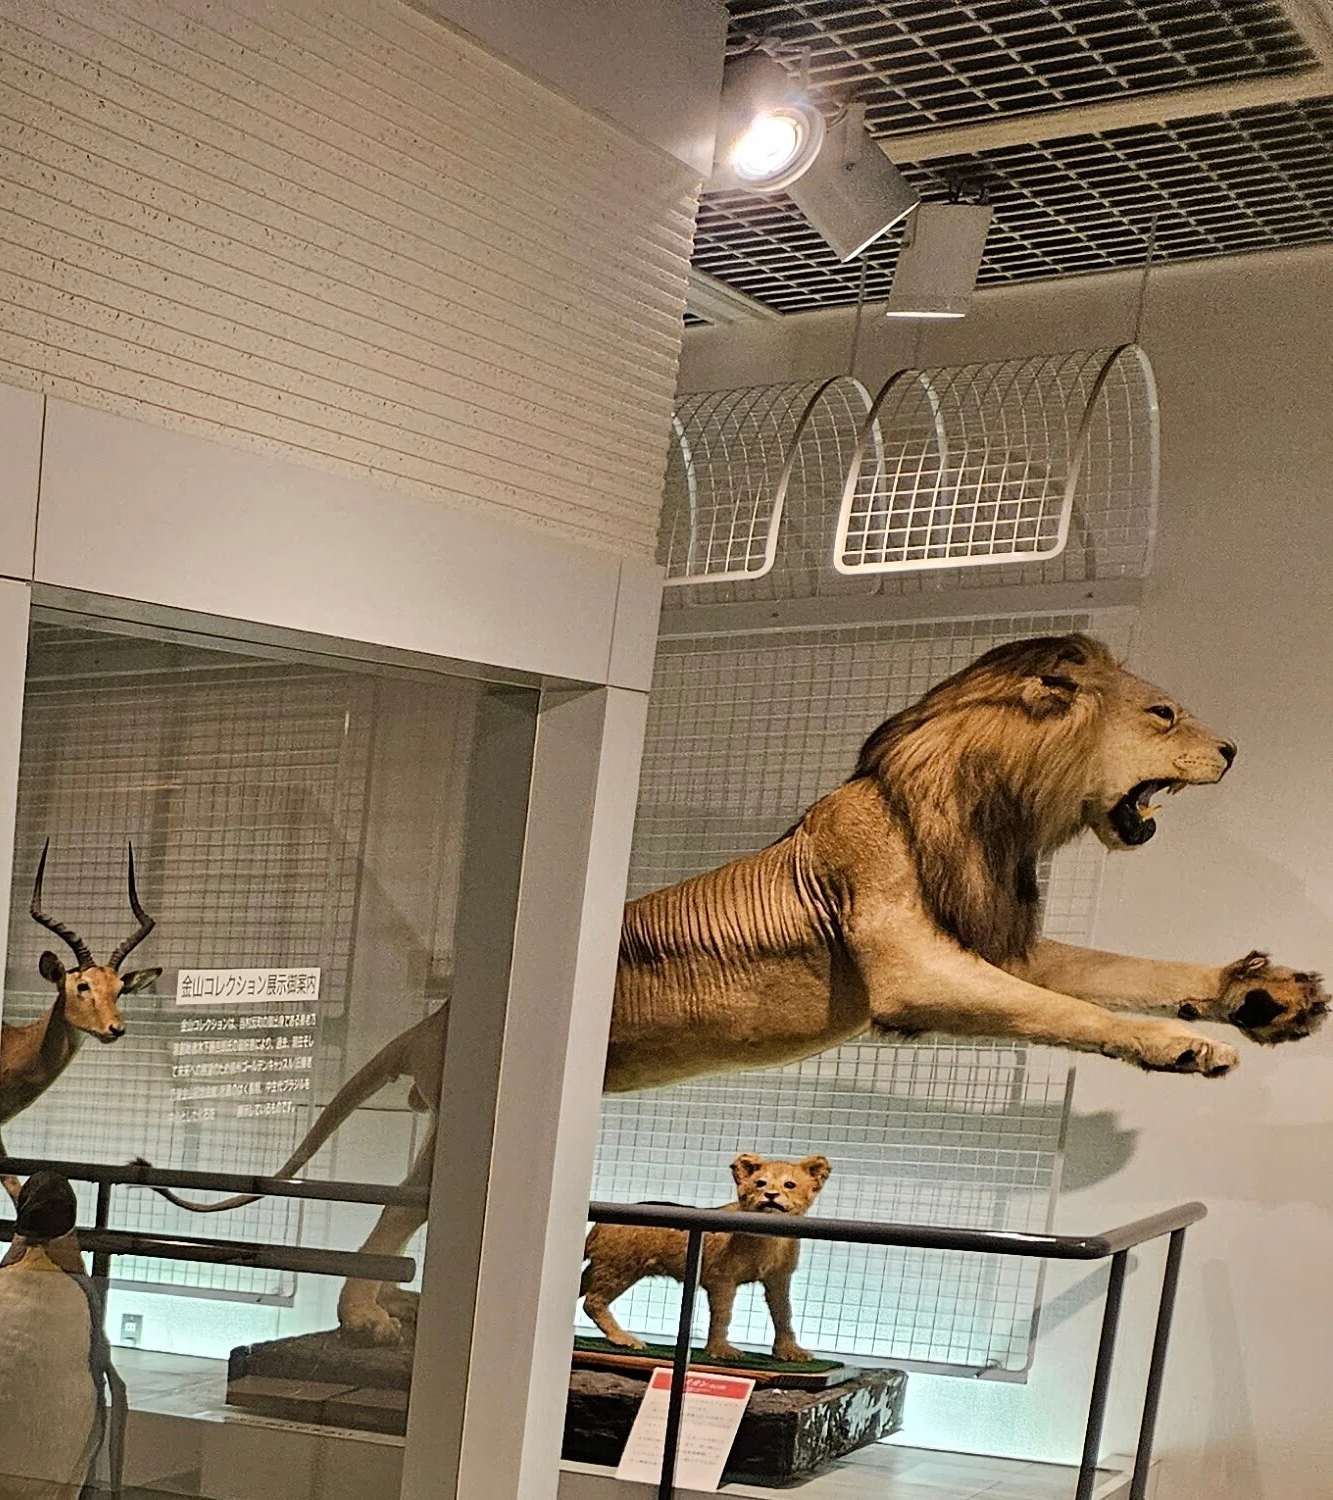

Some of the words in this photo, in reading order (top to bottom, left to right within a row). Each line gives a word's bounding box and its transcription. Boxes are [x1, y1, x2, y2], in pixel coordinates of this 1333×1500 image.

[181, 973, 316, 997] 金山コレクション展示御案内
